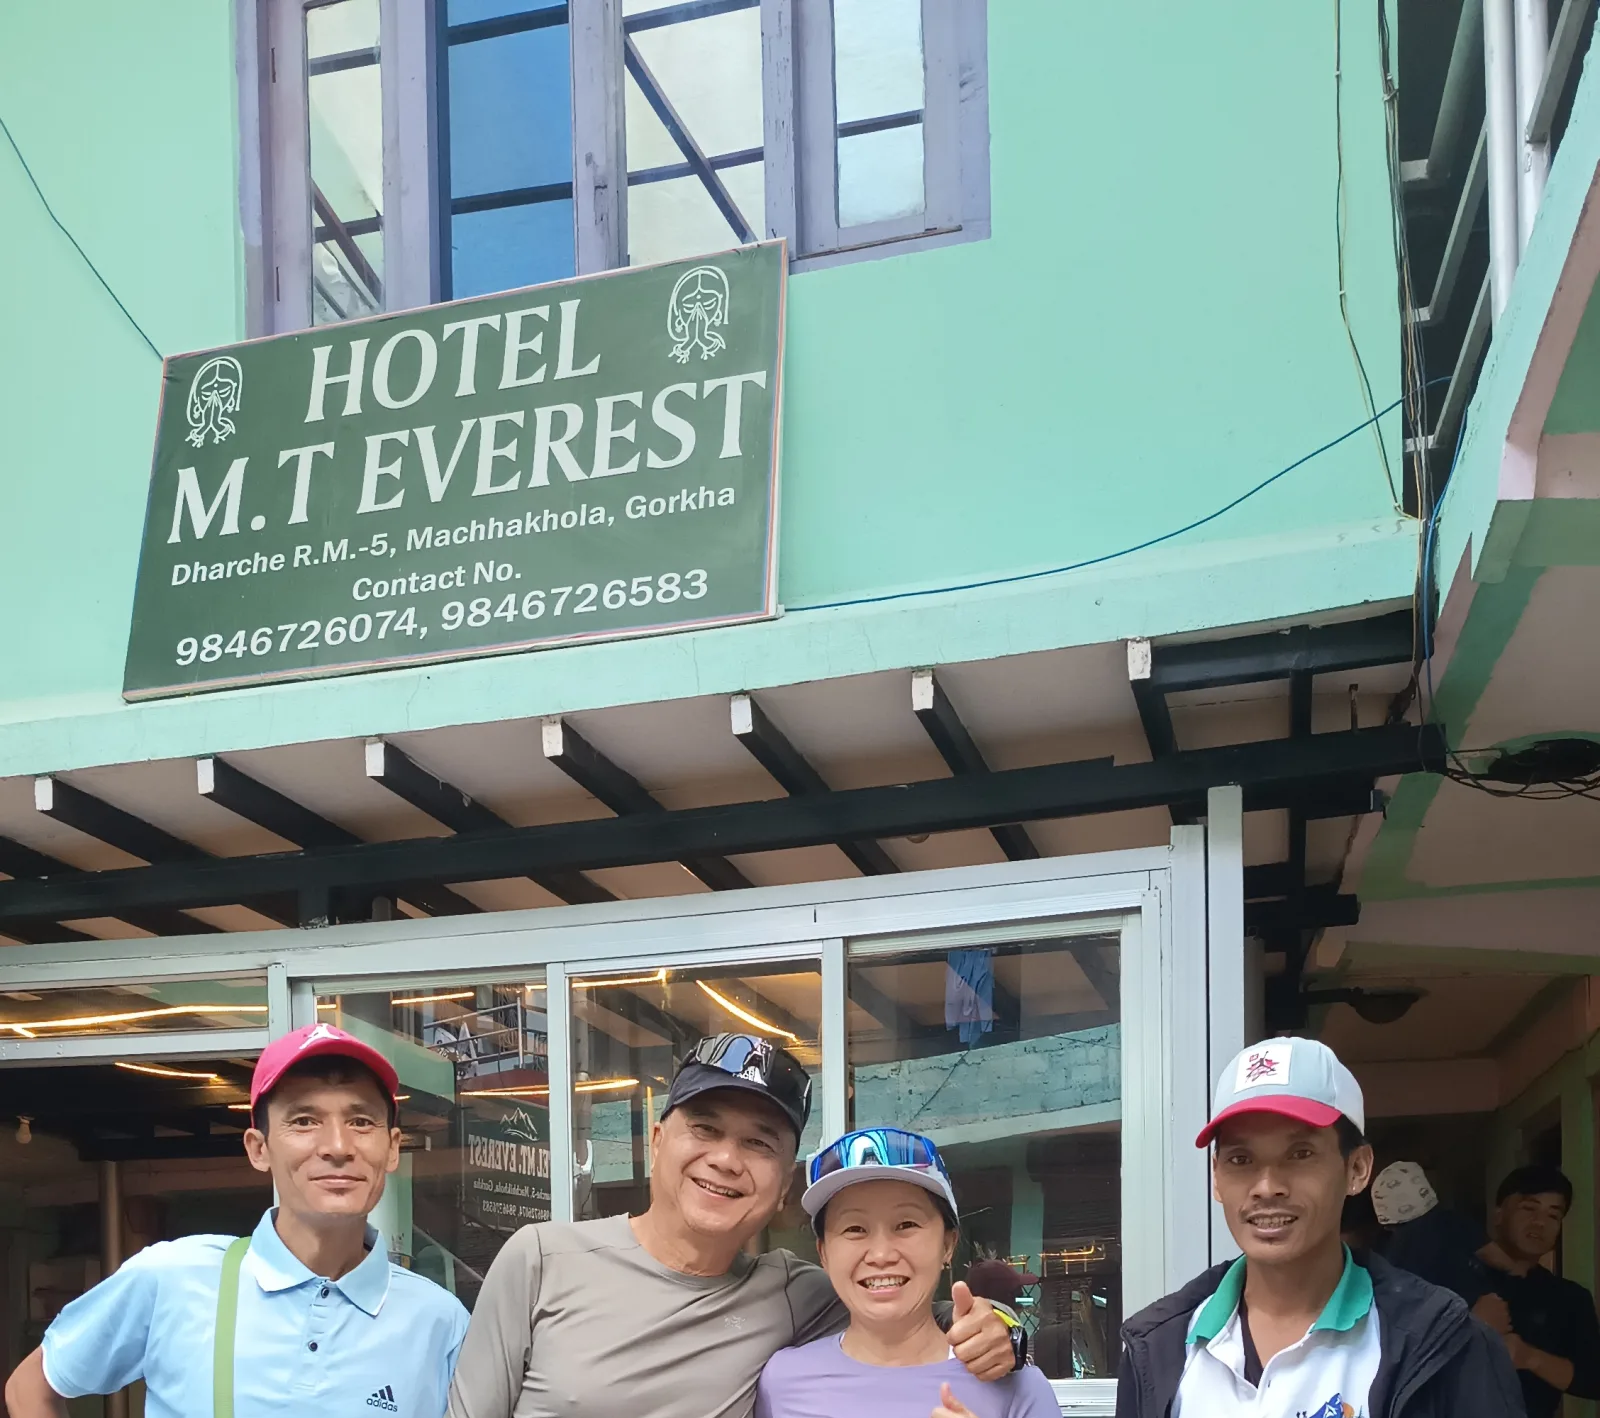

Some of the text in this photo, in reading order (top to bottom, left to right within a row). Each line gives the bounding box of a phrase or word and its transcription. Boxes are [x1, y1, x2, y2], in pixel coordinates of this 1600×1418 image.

[303, 298, 601, 423] HOTEL
[356, 370, 767, 515] EVEREST
[171, 485, 735, 586] Dharche R.M.-5, Machhakhola, Gorkha
[352, 559, 522, 601] Contact No.
[175, 568, 708, 666] 9846726074, 9846726583
[366, 1397, 398, 1412] adidas
